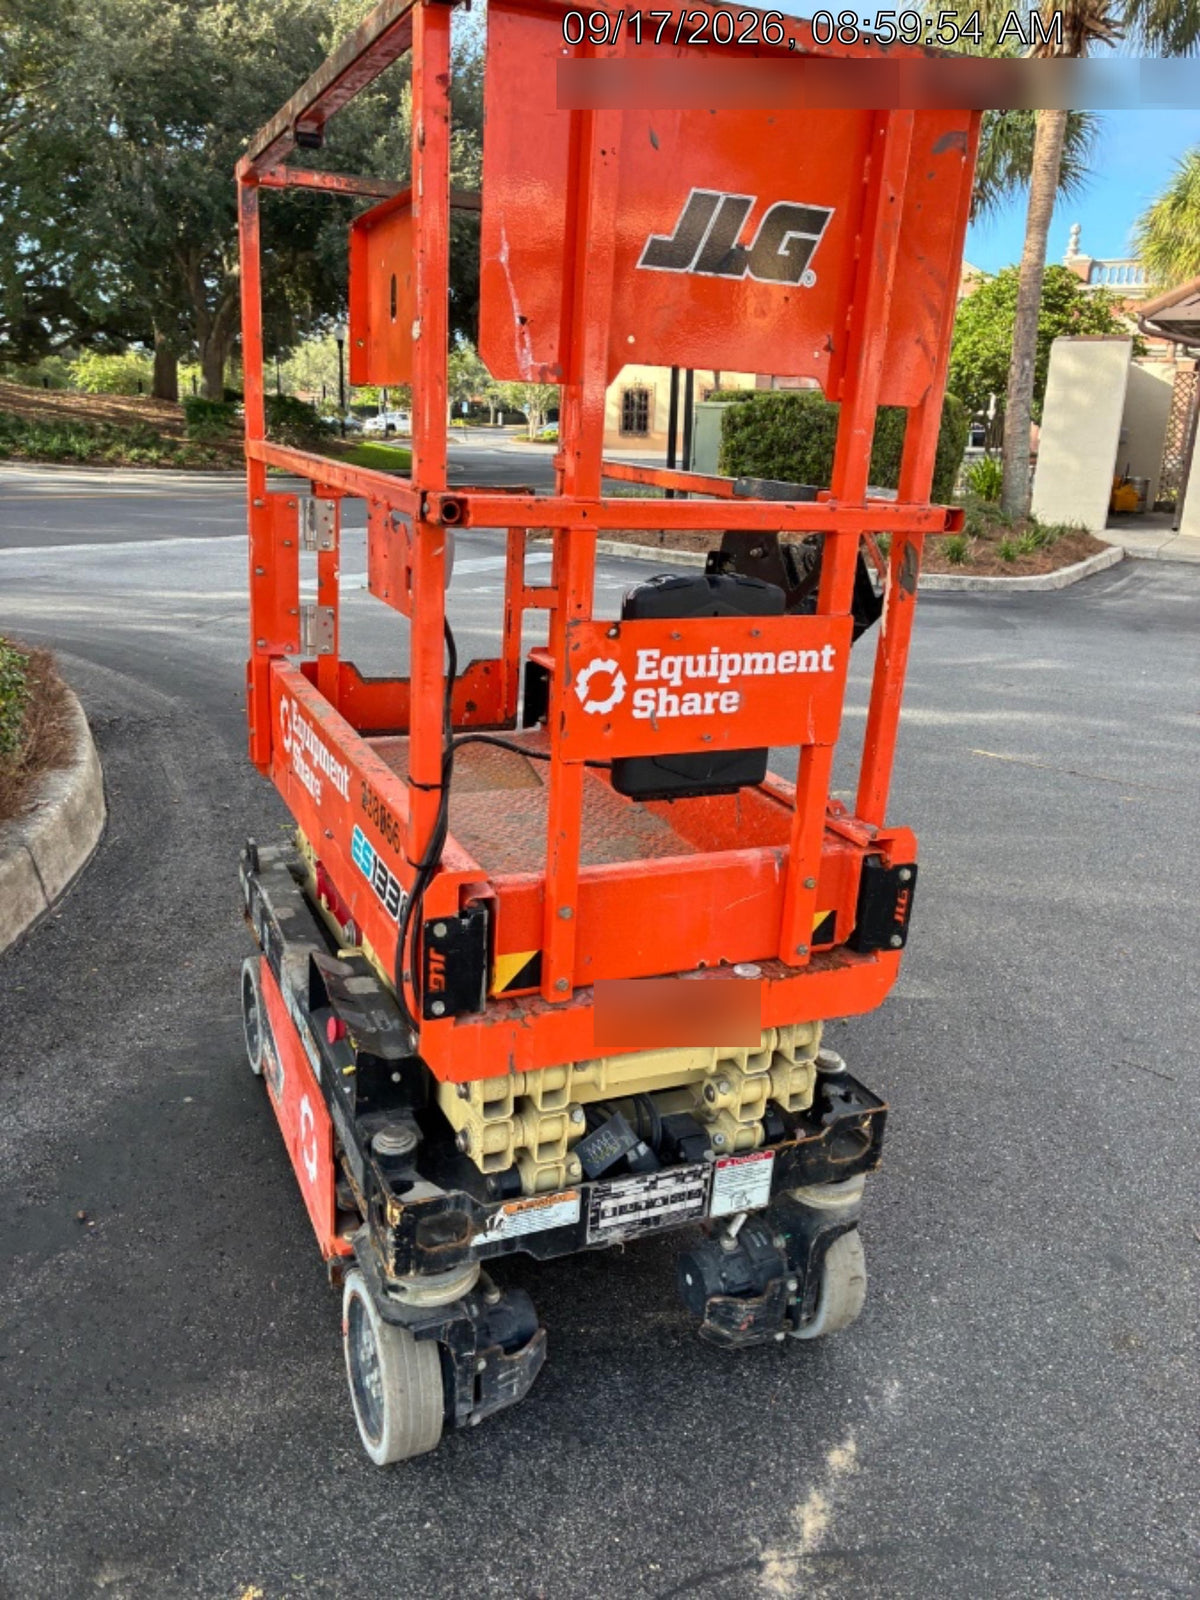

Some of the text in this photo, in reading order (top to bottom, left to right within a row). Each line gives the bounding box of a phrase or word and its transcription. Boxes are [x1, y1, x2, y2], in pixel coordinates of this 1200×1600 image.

[636, 187, 835, 286] JLG
[635, 644, 835, 687] Equipment
[632, 688, 740, 719] Share
[291, 698, 350, 802] Equipment
[292, 740, 321, 806] Share
[429, 947, 446, 992] JLG
